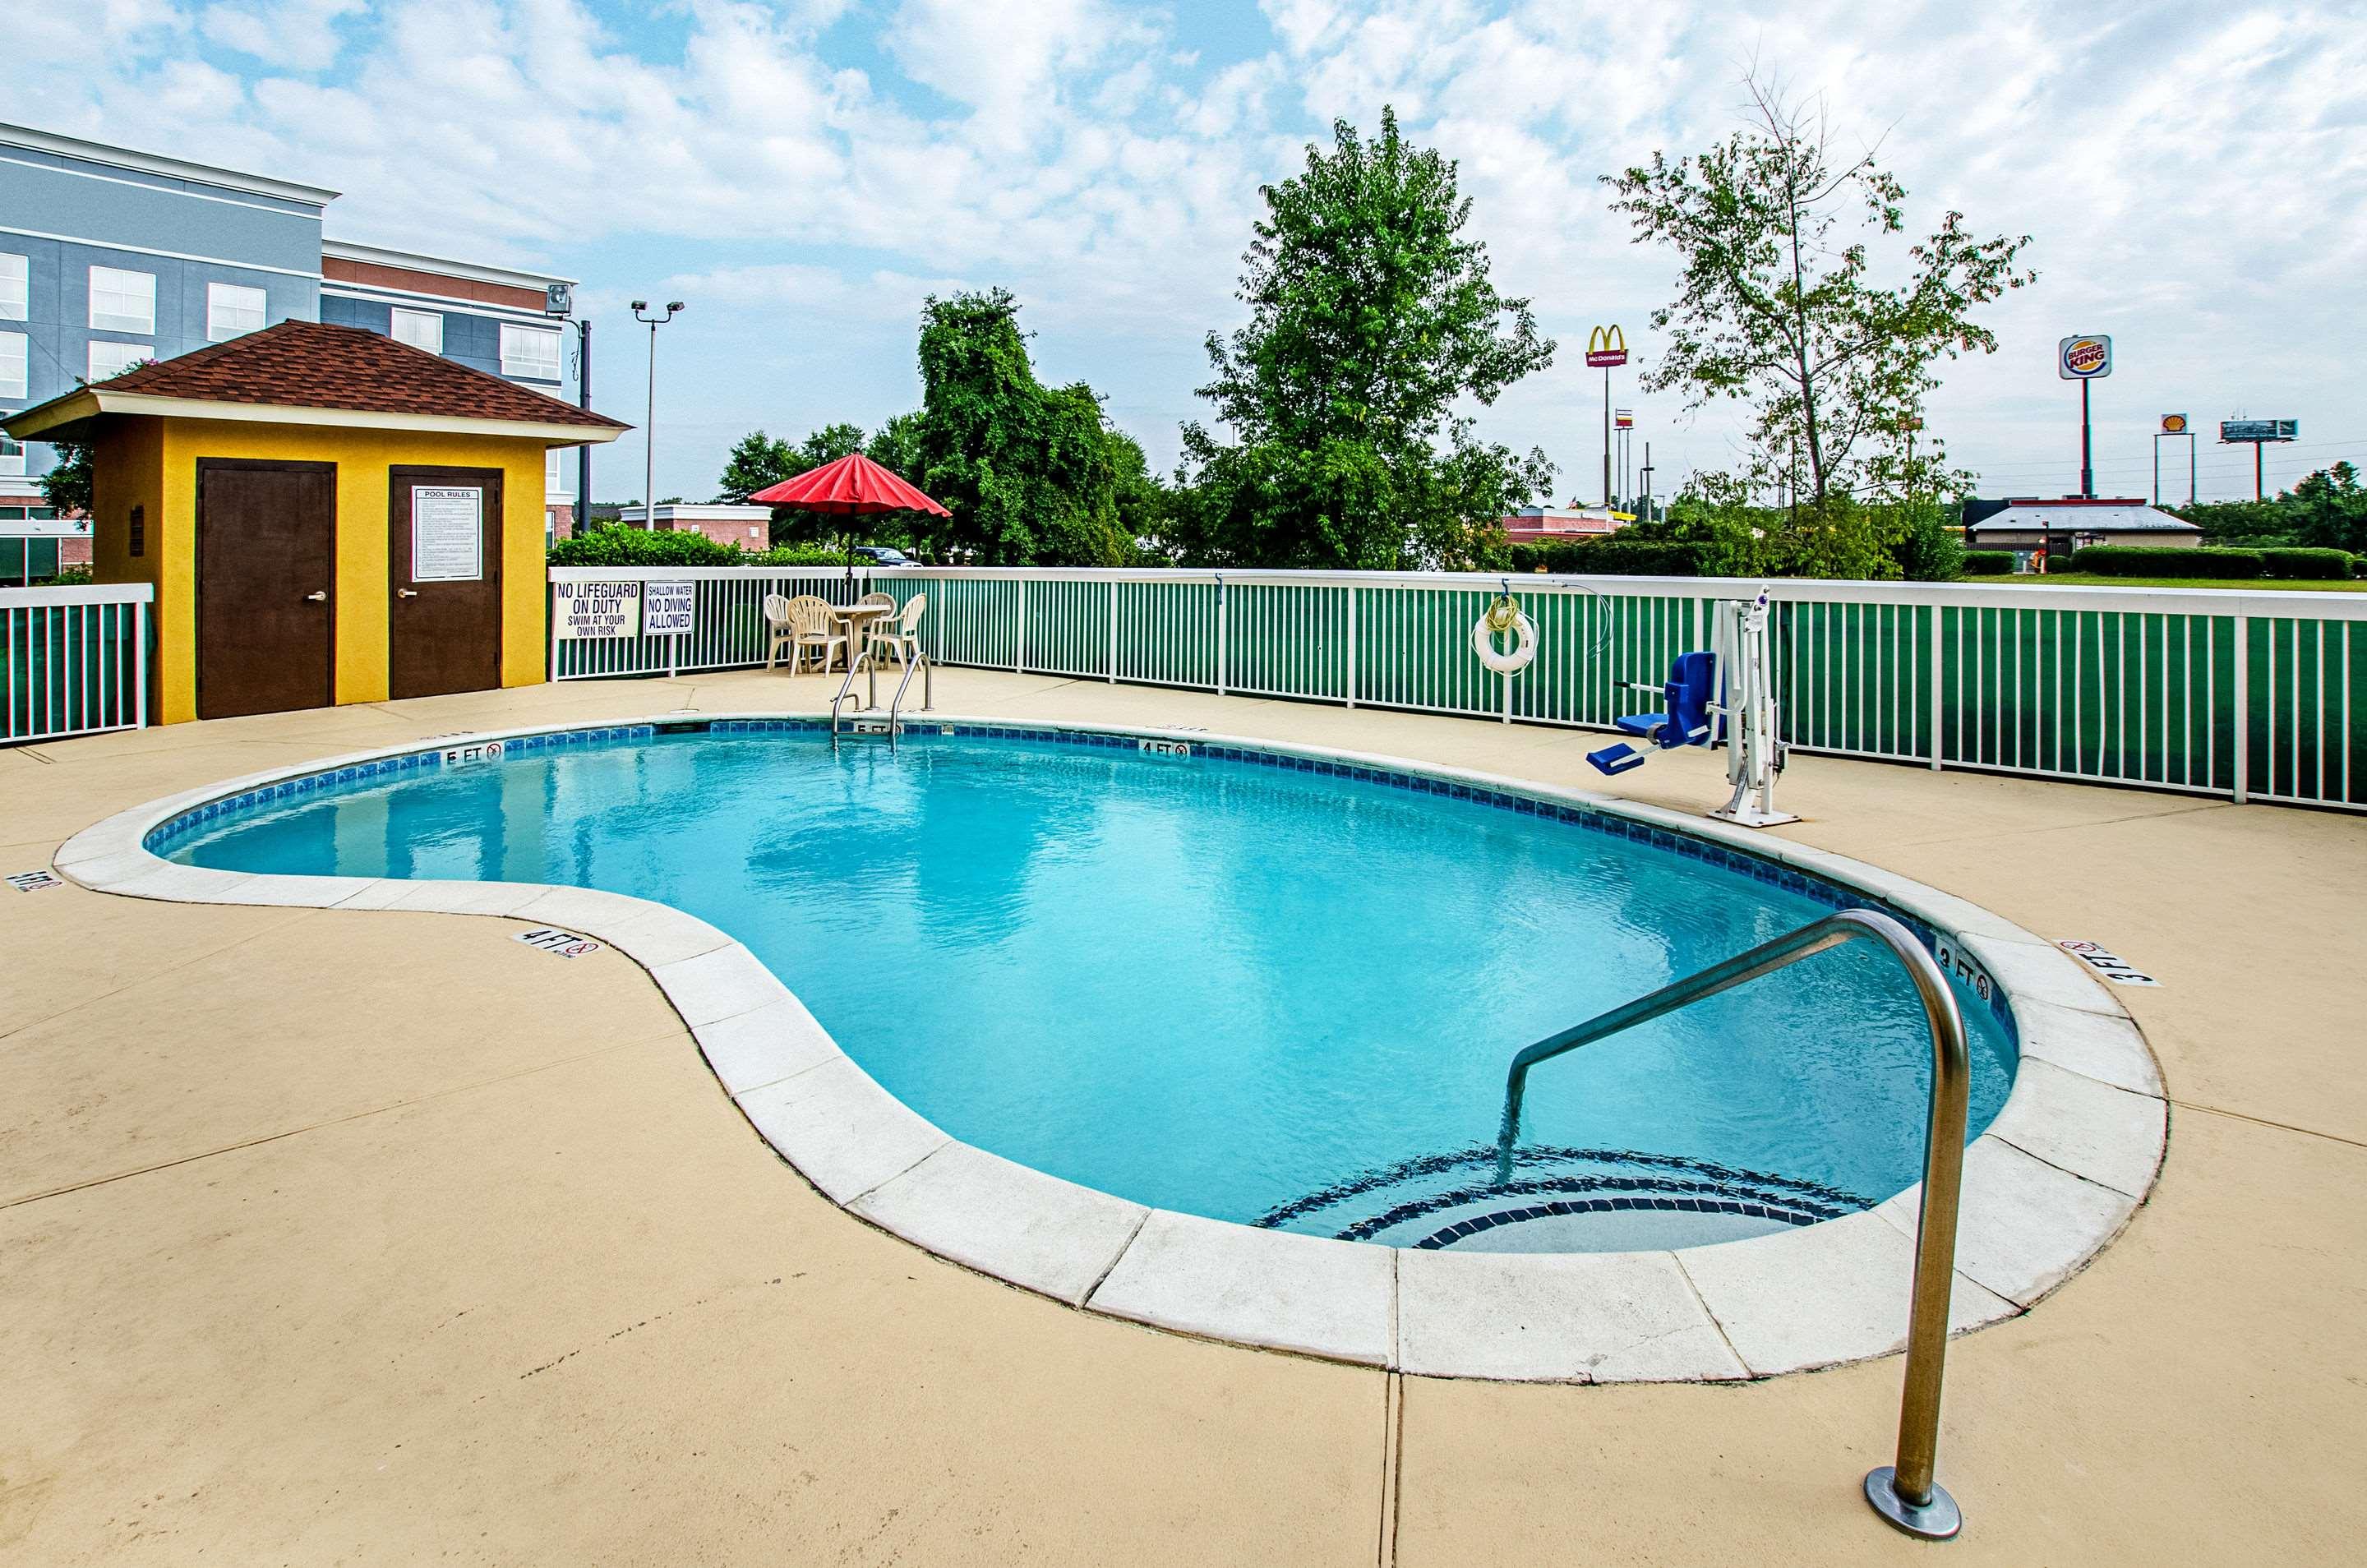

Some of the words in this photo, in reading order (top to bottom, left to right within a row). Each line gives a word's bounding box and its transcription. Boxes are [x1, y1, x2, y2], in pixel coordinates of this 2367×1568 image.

[2069, 344, 2103, 359] BURGER
[2069, 350, 2105, 368] KING
[558, 583, 574, 598] NO
[577, 583, 638, 598] LIFEGUARD
[648, 586, 674, 596] SHALLOW
[676, 585, 692, 595] WATER
[573, 600, 588, 614] ON
[593, 599, 622, 614] DUTY
[648, 598, 662, 613] NO
[664, 597, 691, 612] DIVING
[568, 616, 590, 625] SWIM
[593, 616, 602, 625] AT
[605, 615, 625, 625] YOUR
[649, 614, 690, 629] ALLOWED
[577, 626, 595, 636] OWN
[598, 625, 616, 636] RISK
[464, 747, 482, 762] FT
[1143, 742, 1151, 751] 4
[1156, 743, 1171, 754] FT
[523, 930, 552, 939] 4
[530, 934, 584, 949] FT
[1940, 948, 1949, 968] 3
[1956, 958, 1973, 986] FT
[2079, 953, 2132, 970] FT
[2106, 973, 2154, 982] 3
